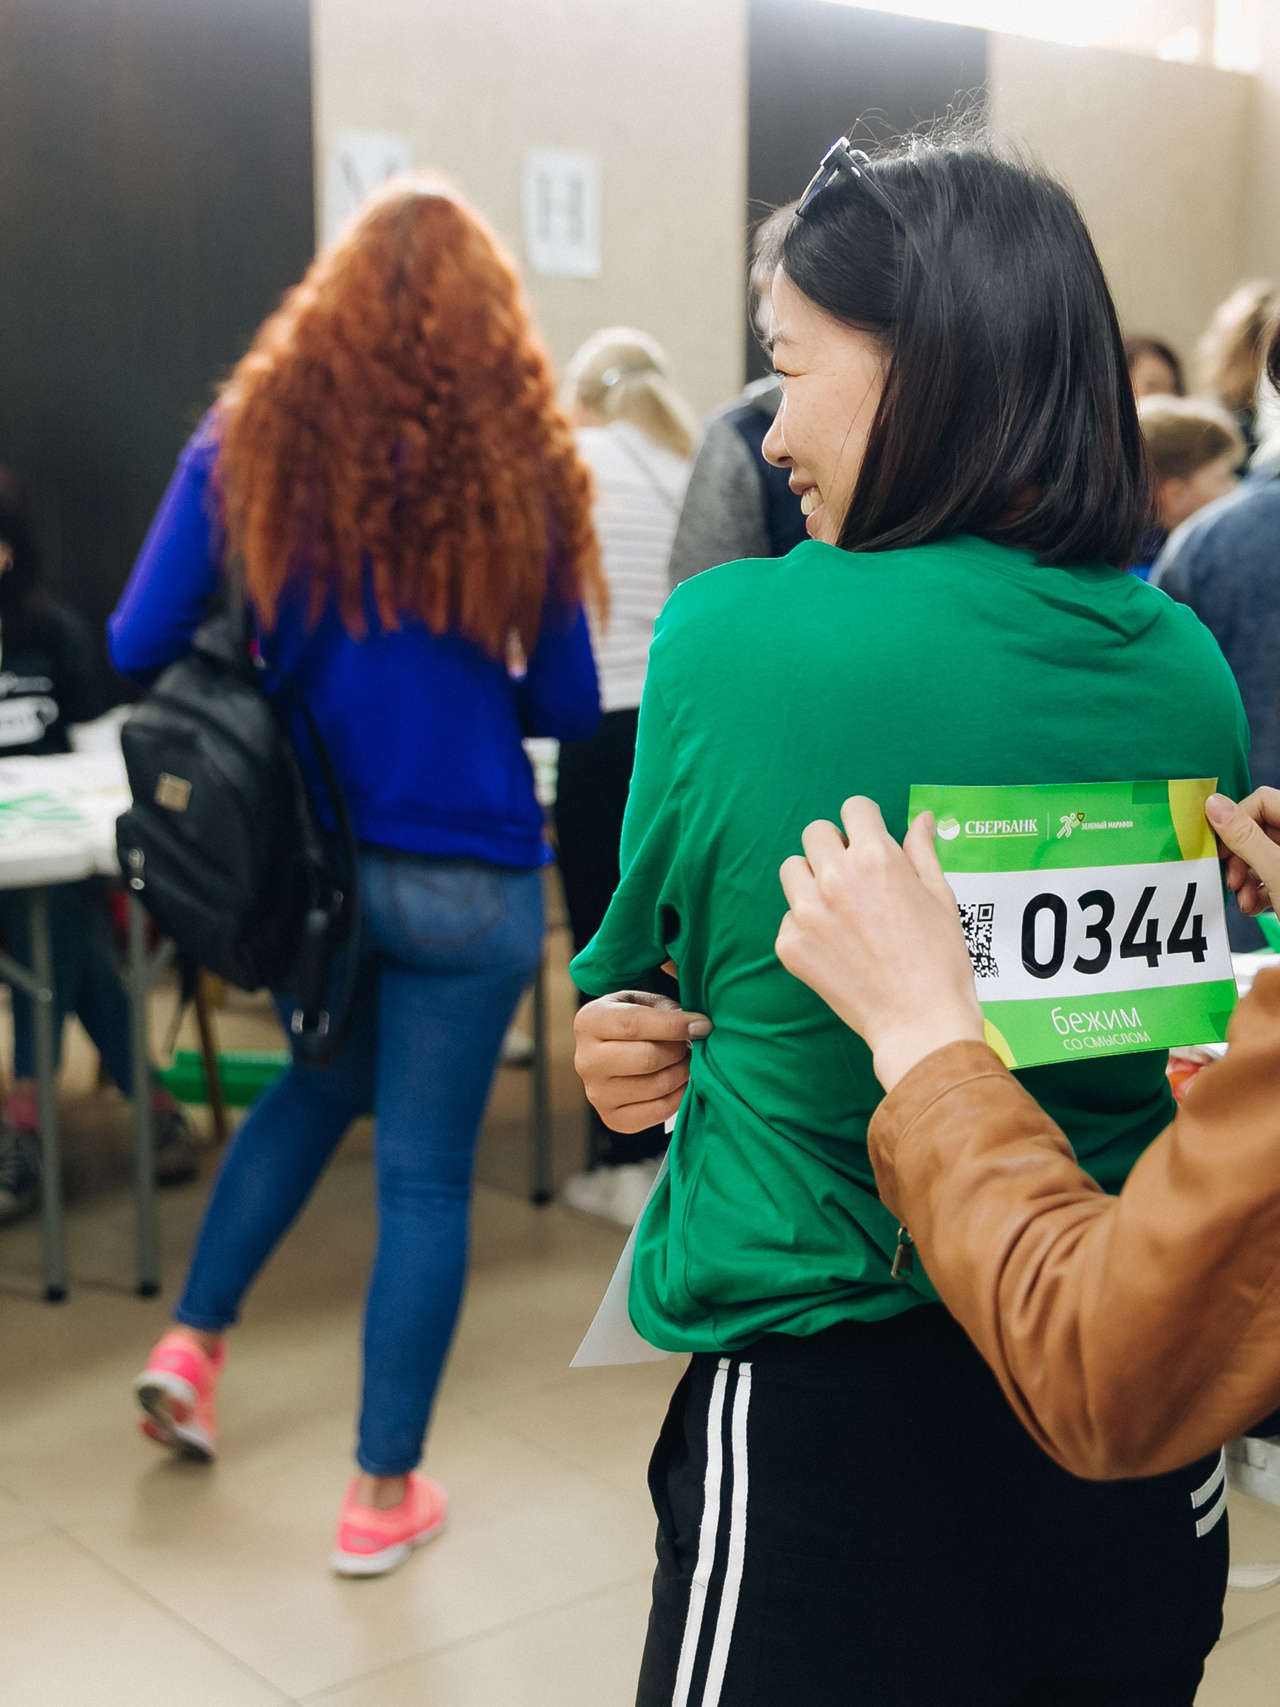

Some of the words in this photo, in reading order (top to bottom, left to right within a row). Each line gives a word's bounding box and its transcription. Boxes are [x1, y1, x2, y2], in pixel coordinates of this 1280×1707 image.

[964, 818, 1038, 835] СБЕРБАНК
[1021, 882, 1208, 980] 0344
[1051, 1006, 1142, 1035] бежим
